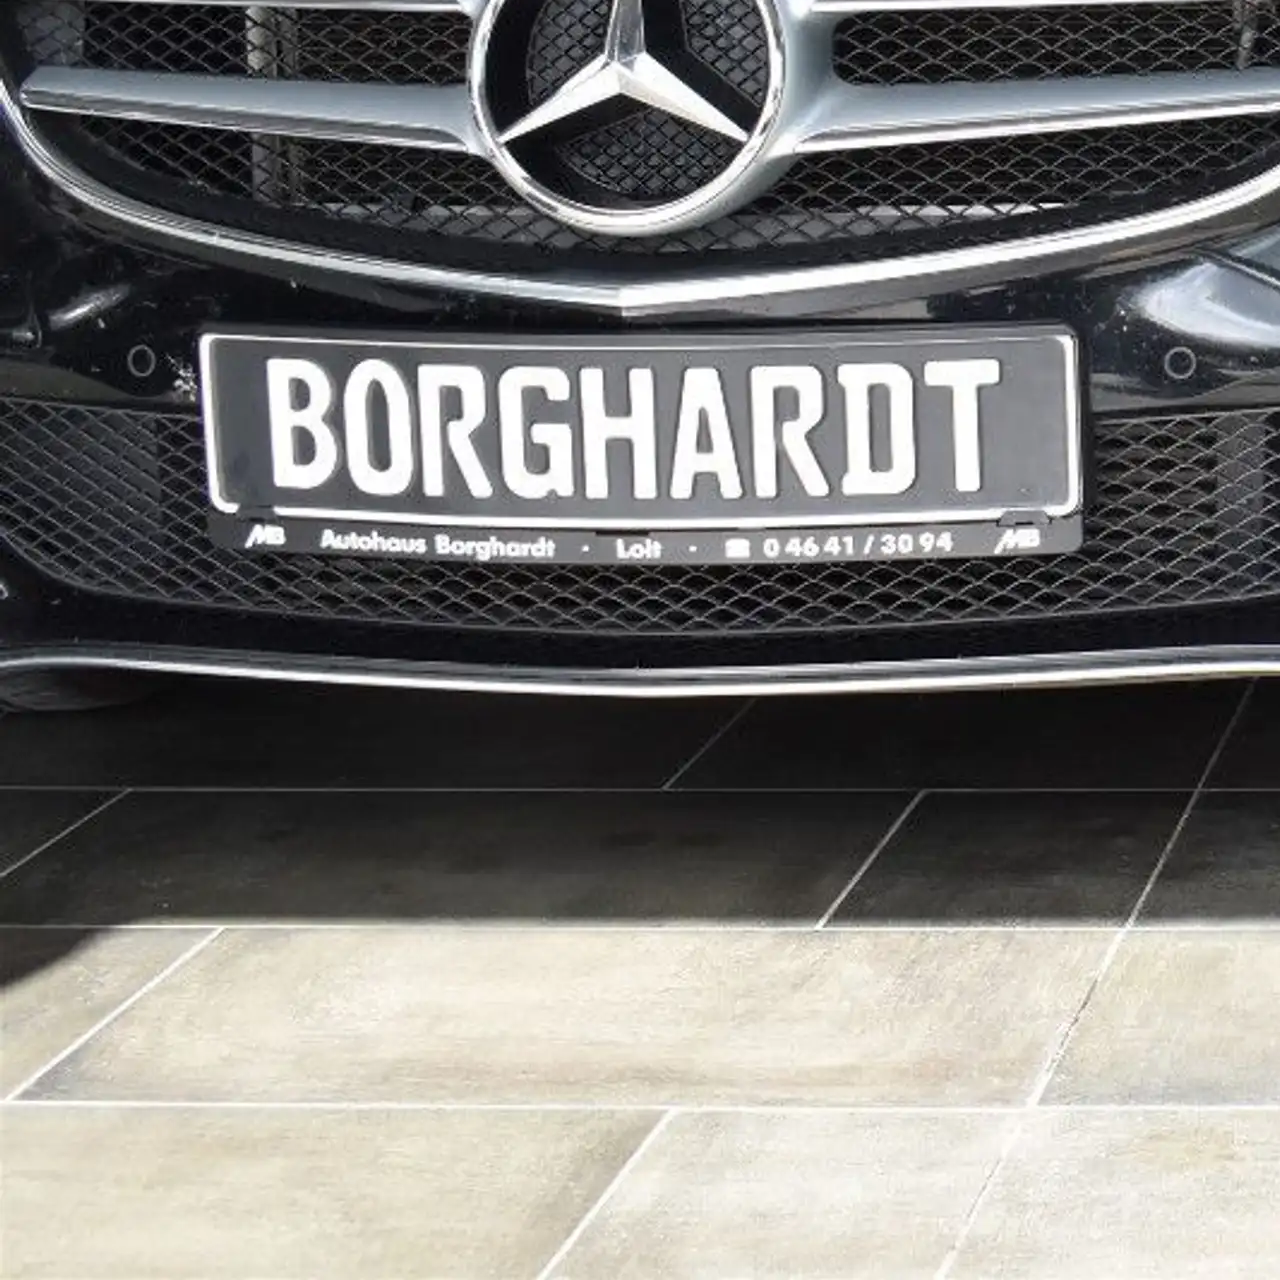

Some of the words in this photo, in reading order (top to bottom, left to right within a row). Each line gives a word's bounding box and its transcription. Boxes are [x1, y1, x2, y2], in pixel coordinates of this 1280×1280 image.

[266, 357, 1000, 500] BORGHARDT
[320, 528, 427, 554] Autohaus
[434, 533, 556, 562] Borghardt
